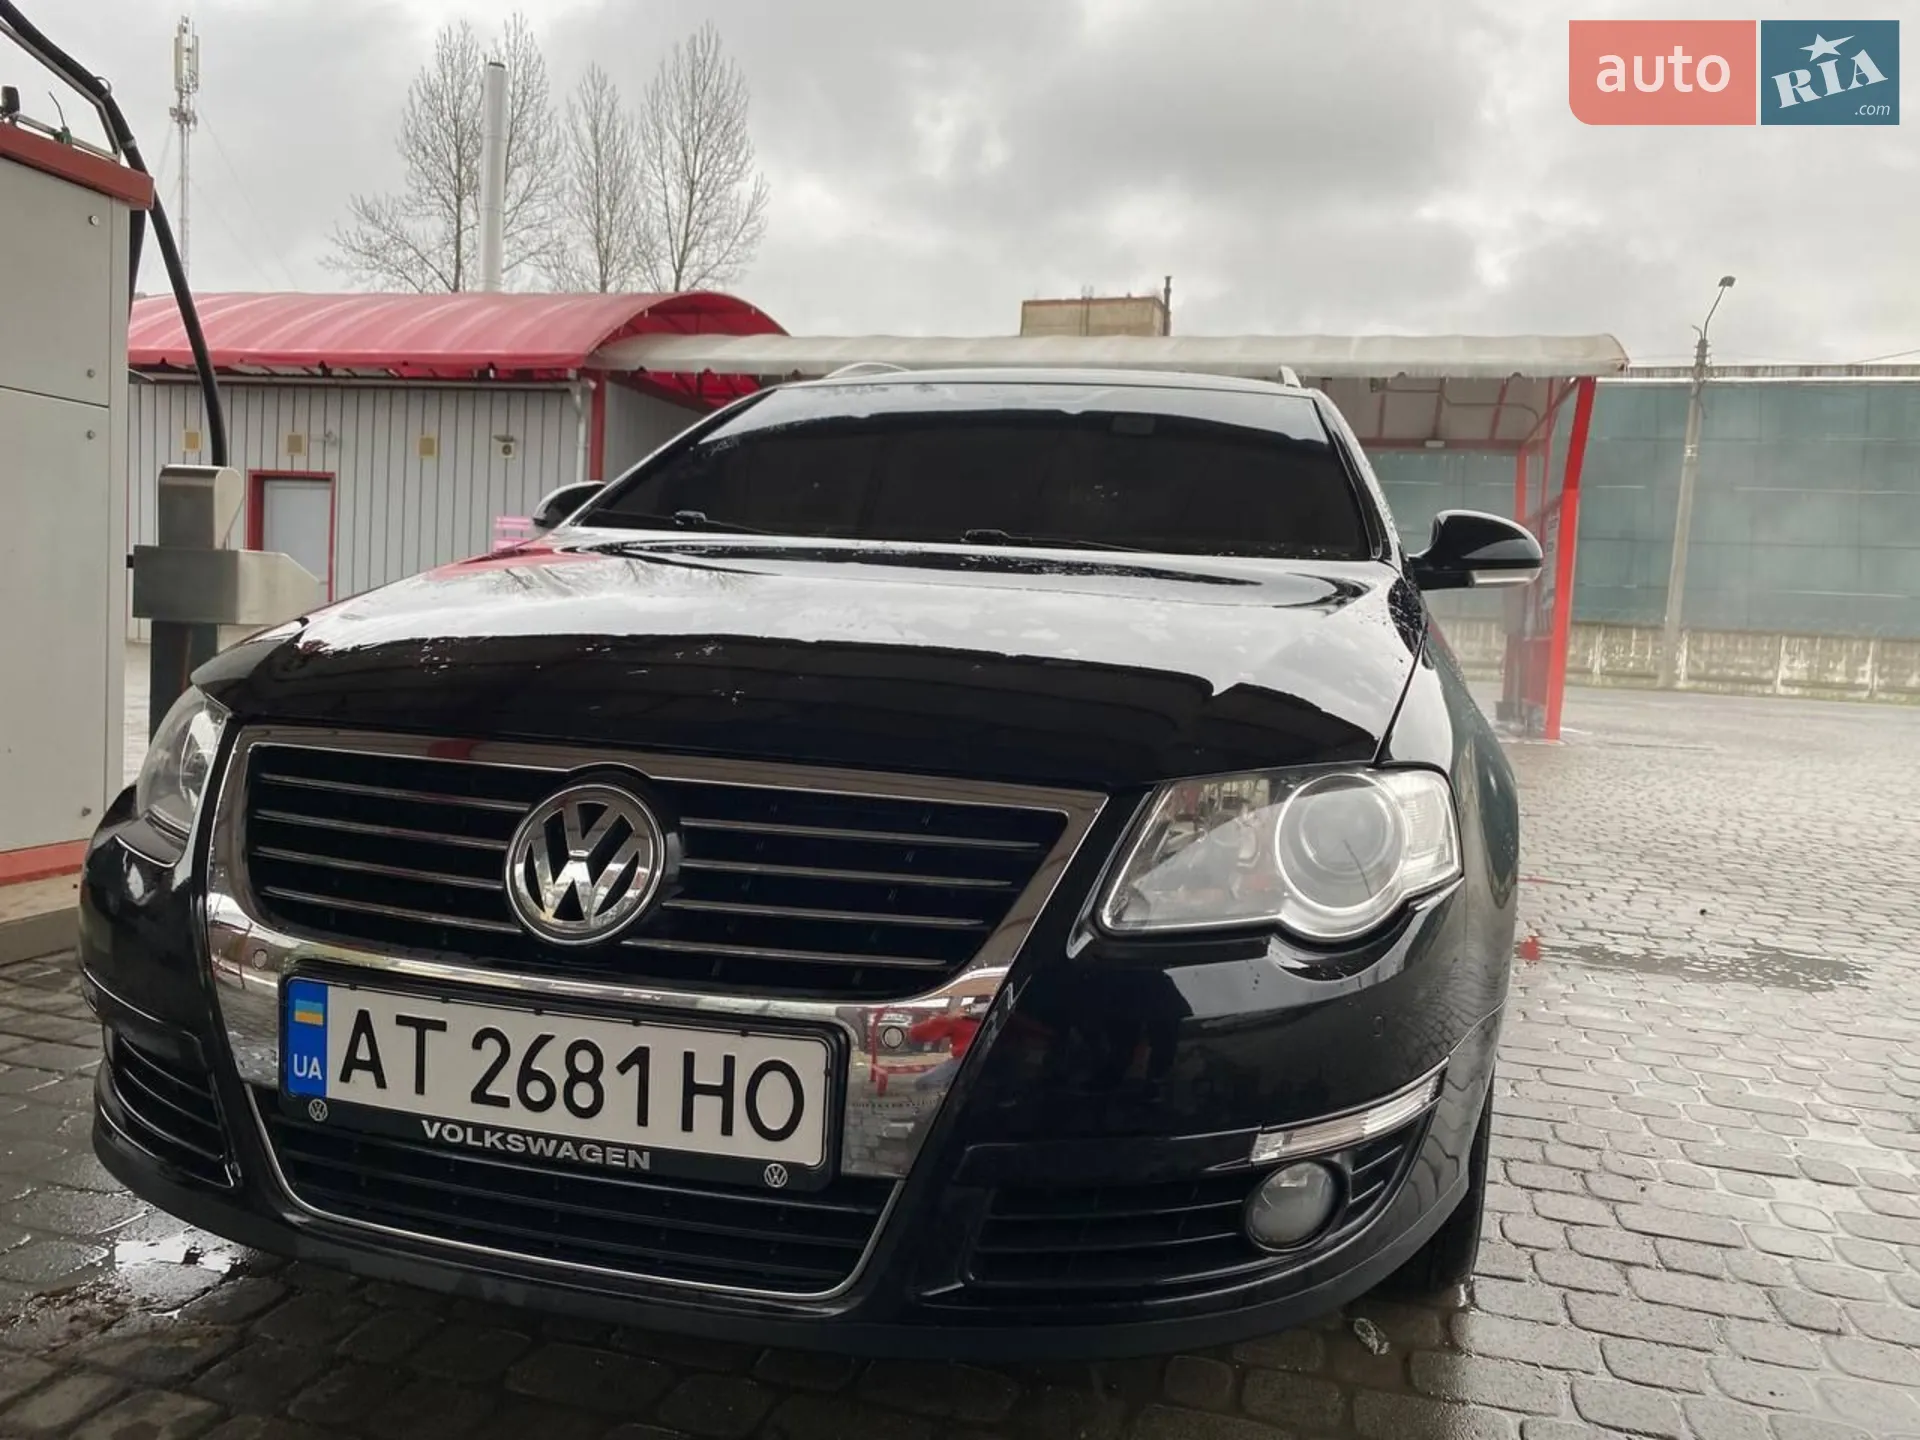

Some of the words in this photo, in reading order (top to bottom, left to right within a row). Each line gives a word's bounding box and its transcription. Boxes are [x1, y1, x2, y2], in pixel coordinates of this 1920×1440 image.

[293, 1053, 322, 1081] UA
[339, 1008, 447, 1096] AT
[470, 1027, 651, 1128] 2681
[680, 1050, 805, 1142] HO
[421, 1119, 650, 1171] VOLKSWAGEN
